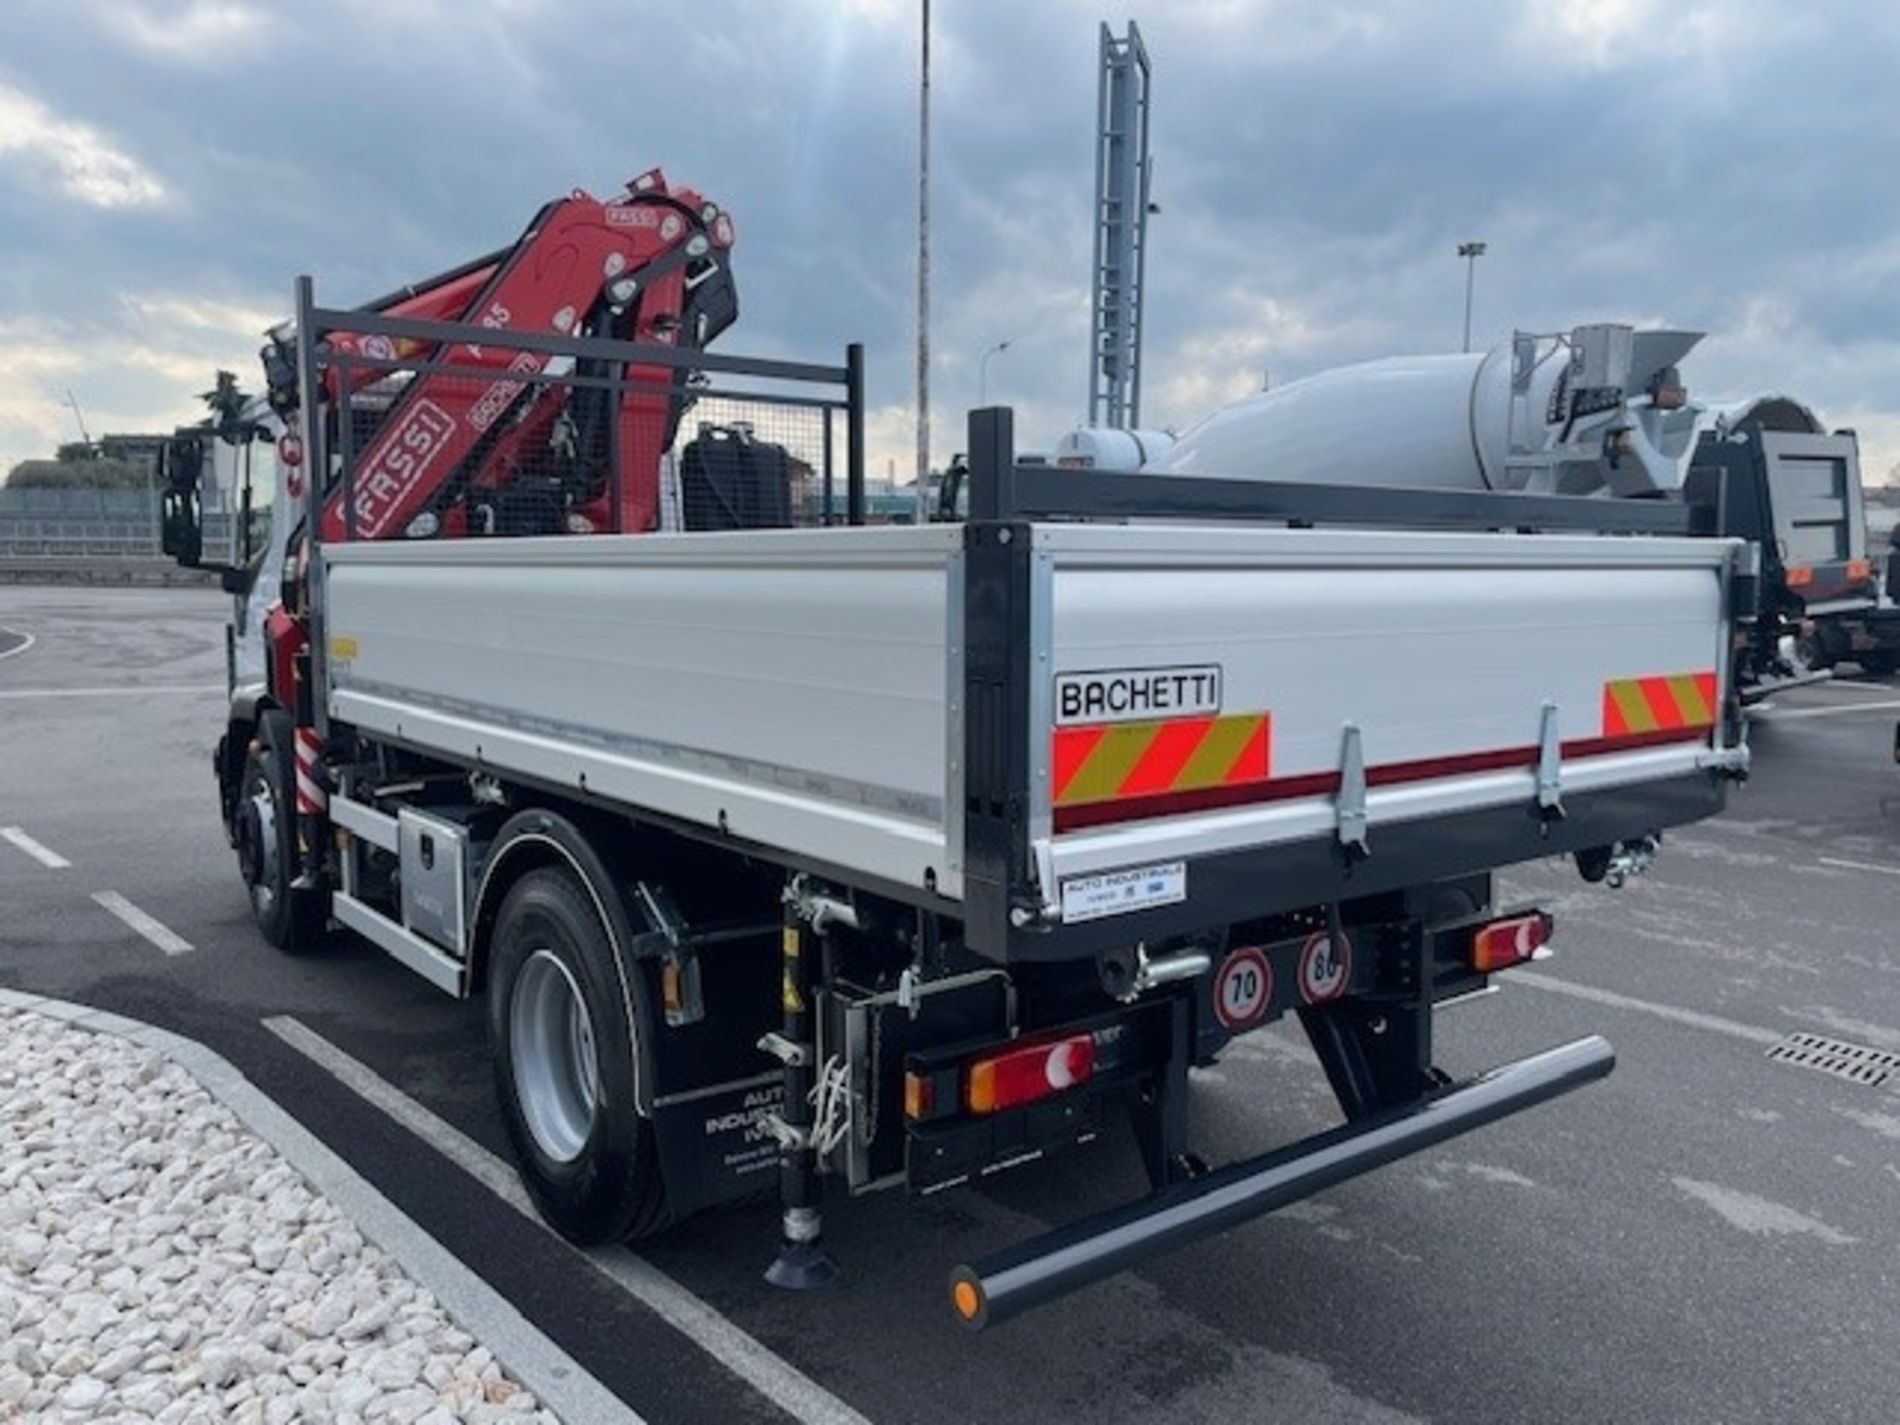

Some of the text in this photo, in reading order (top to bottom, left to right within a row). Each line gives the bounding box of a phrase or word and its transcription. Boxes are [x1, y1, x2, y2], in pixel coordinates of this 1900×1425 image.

[354, 413, 442, 522] FASSI
[1060, 673, 1216, 717] BACHETTI
[1069, 880, 1101, 892] AUTO
[1231, 969, 1257, 1003] 70
[743, 1085, 785, 1108] AUT
